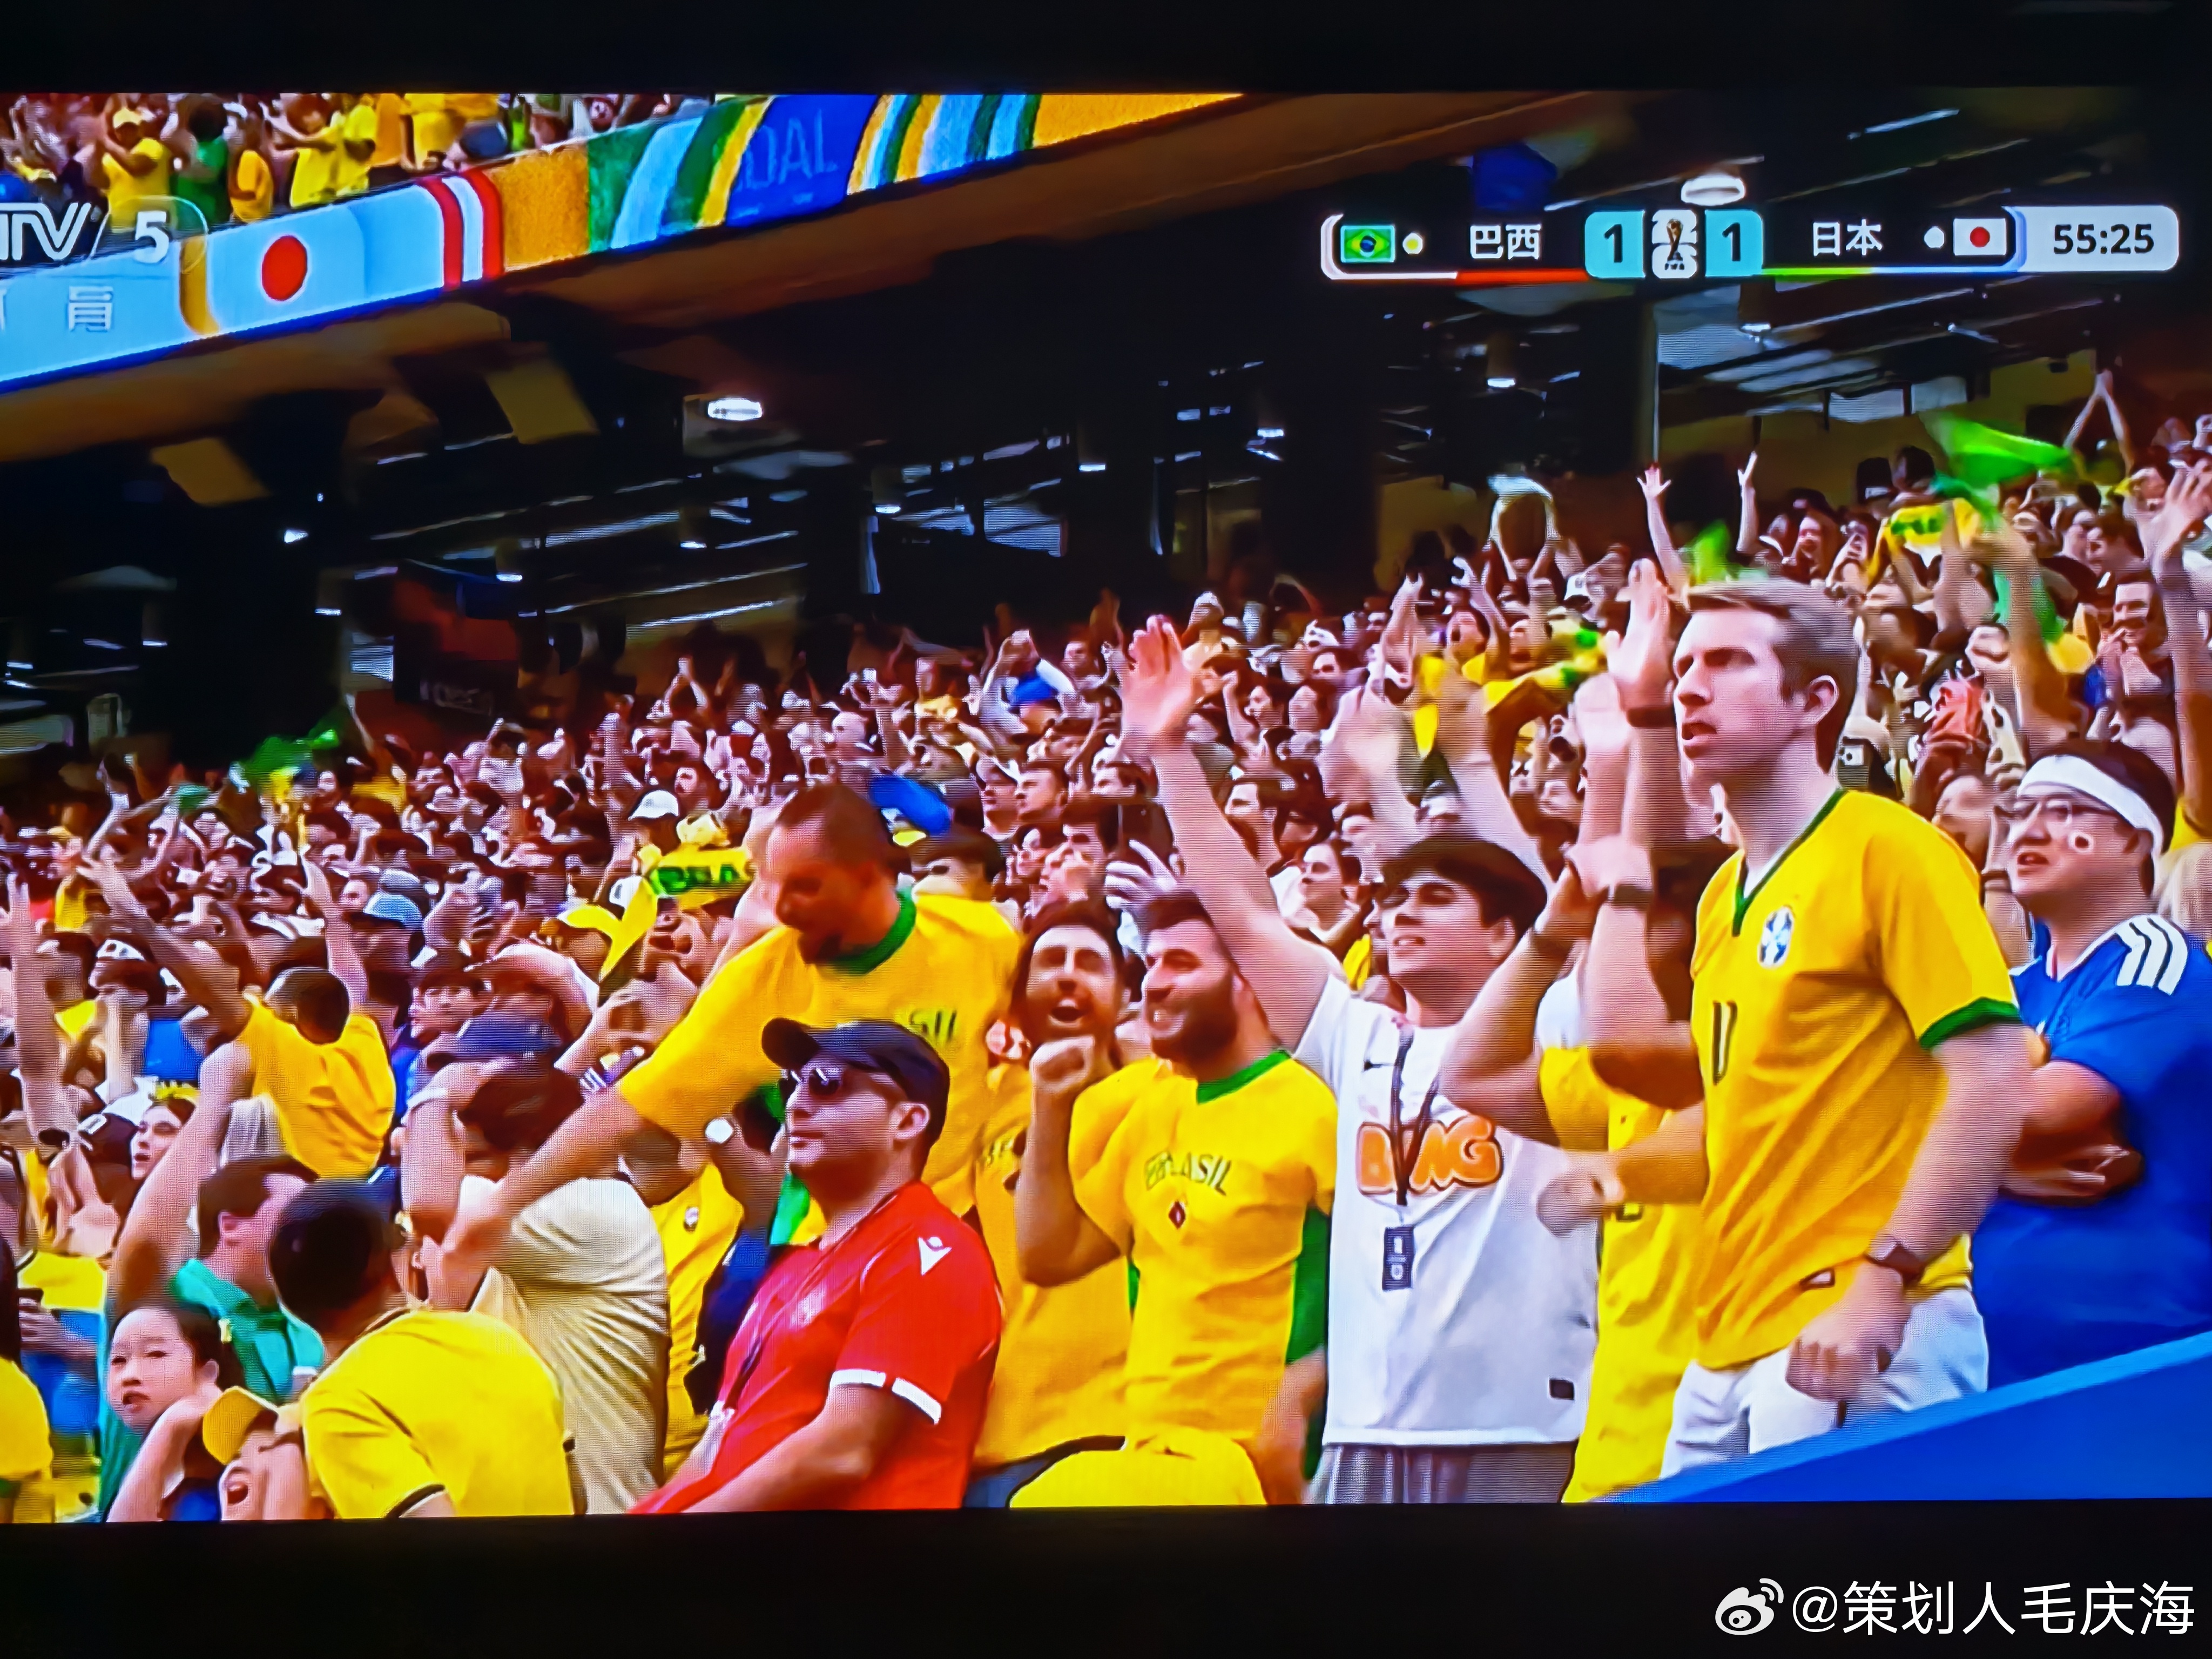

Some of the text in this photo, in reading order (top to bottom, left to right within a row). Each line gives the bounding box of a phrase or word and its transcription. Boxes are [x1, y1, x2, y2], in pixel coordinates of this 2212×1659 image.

[135, 211, 170, 264] 5
[1470, 224, 1542, 260] 巴西
[1604, 224, 1623, 262] 1
[1722, 222, 1741, 262] 1
[1812, 219, 1883, 257] 日本
[2053, 223, 2155, 254] 55:25
